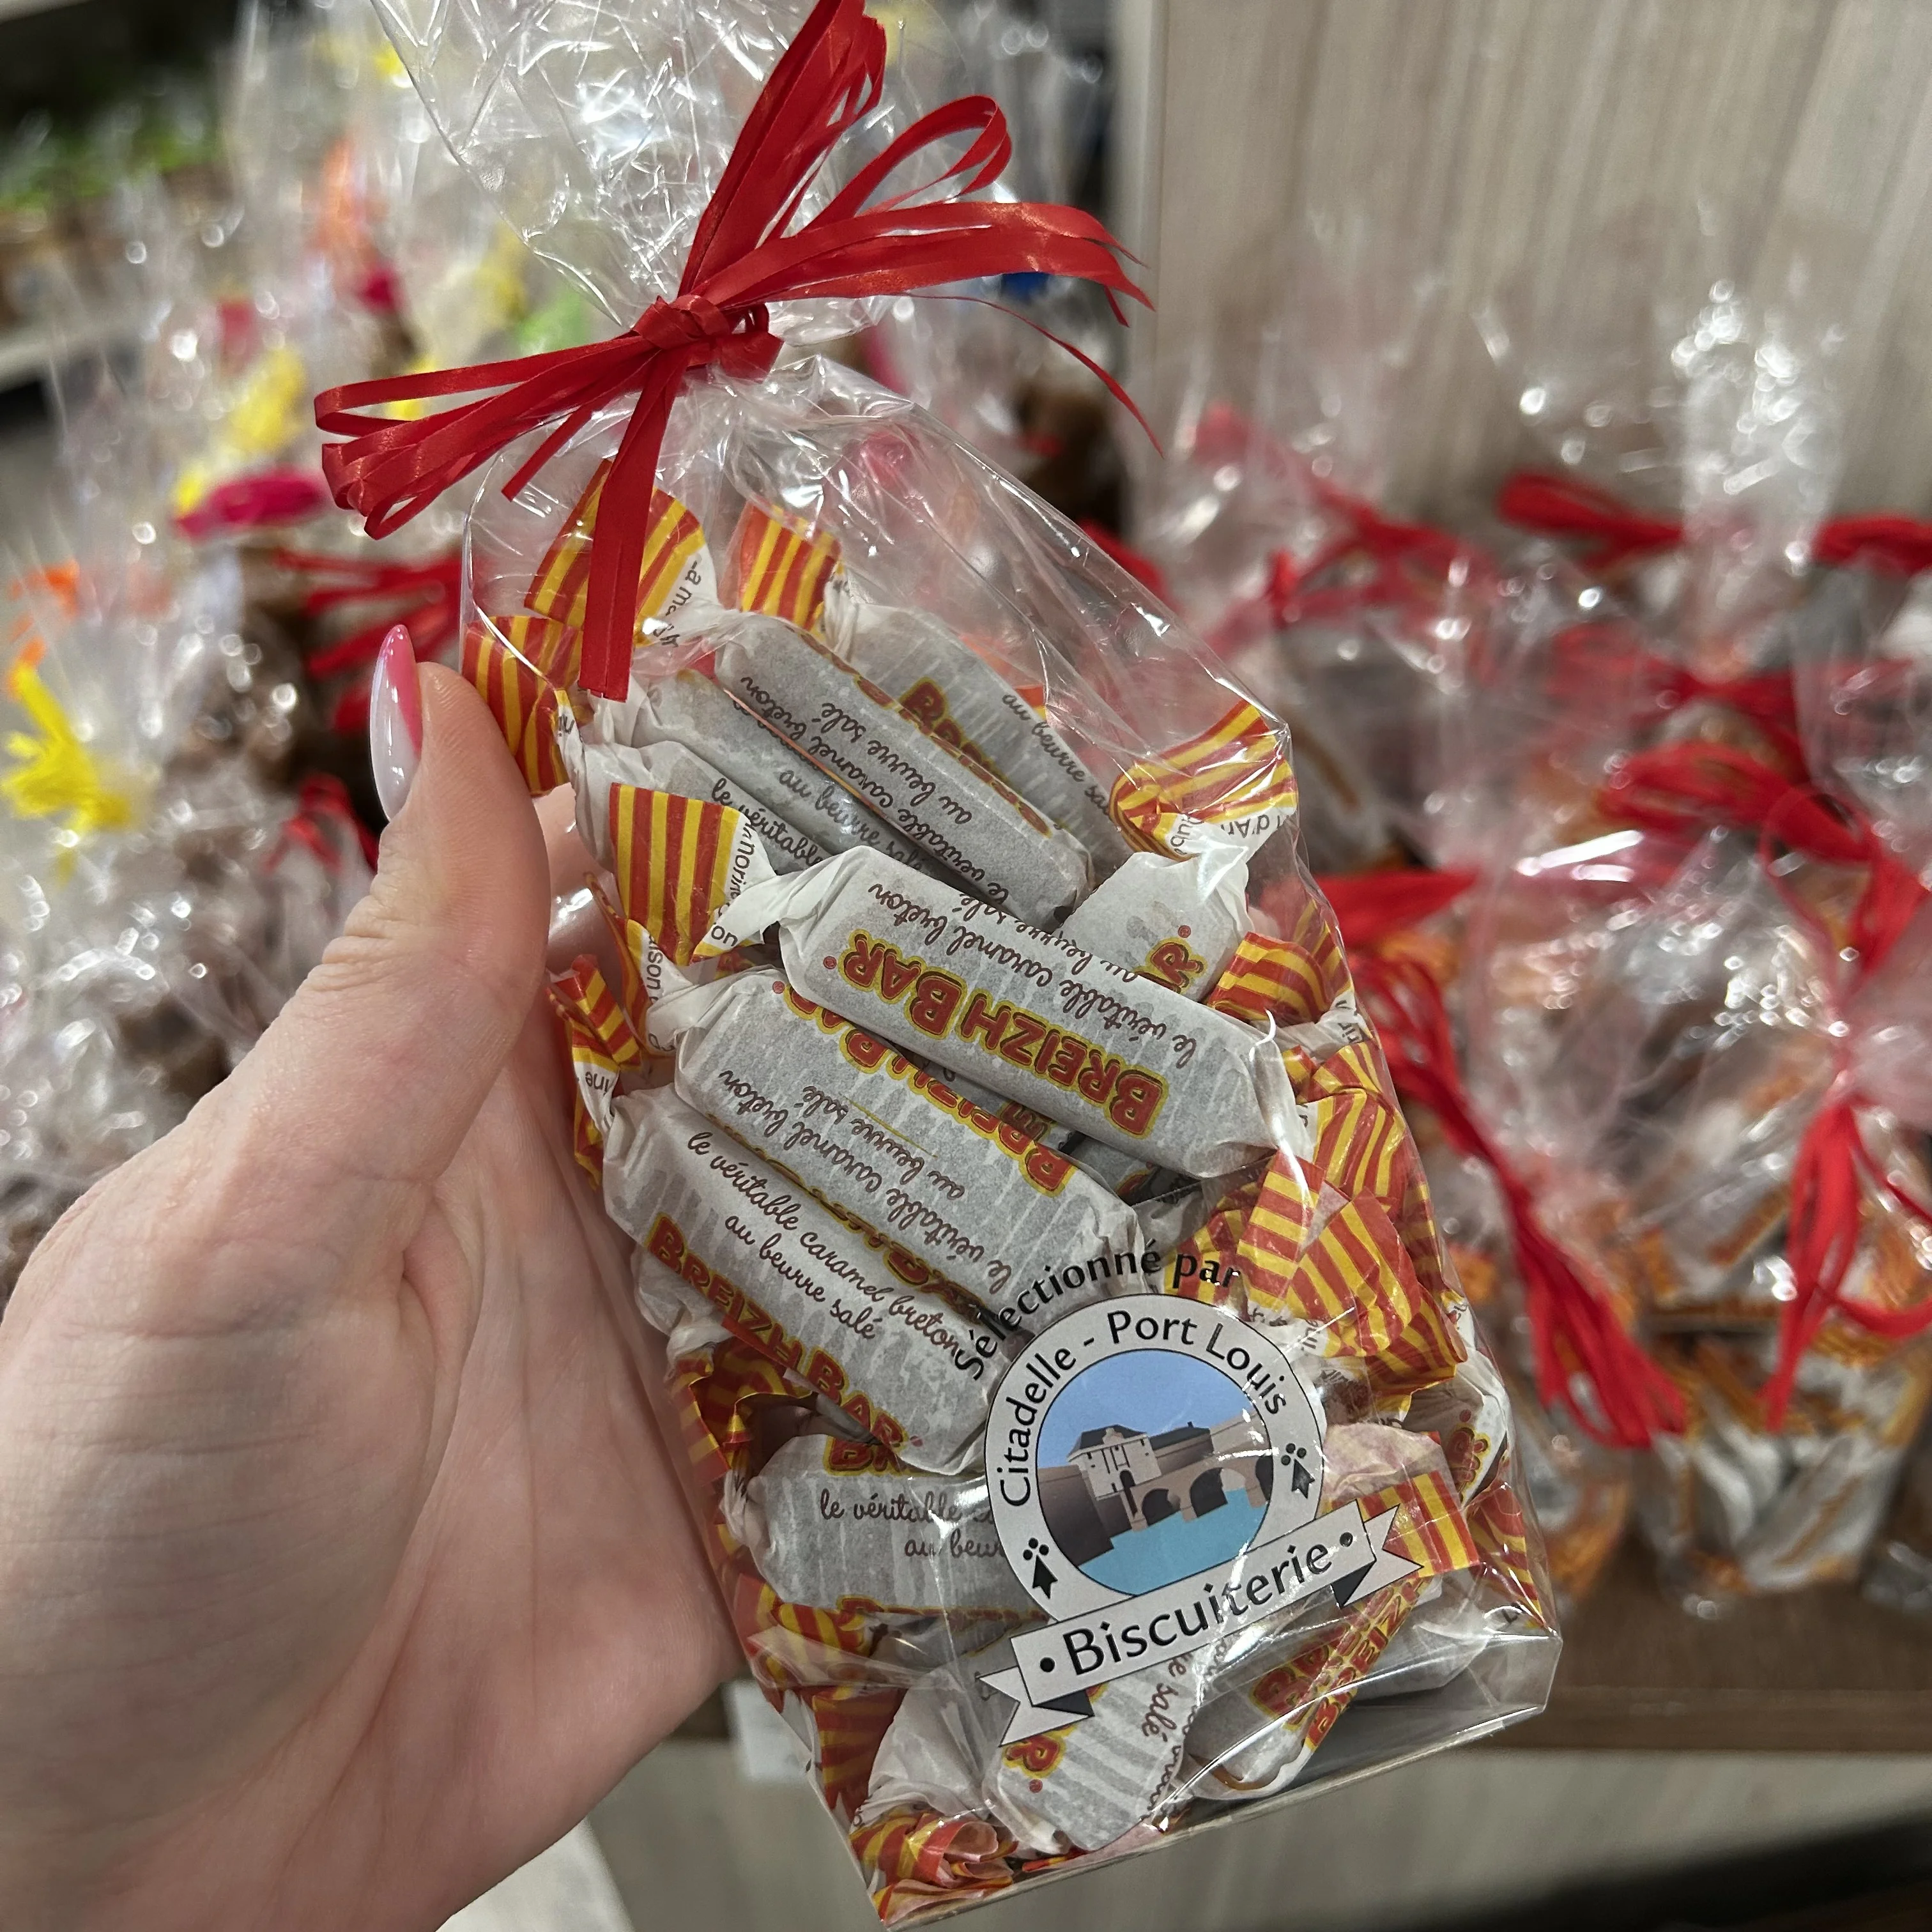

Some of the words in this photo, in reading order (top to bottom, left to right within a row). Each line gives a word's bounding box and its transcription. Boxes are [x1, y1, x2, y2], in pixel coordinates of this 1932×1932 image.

[740, 677, 807, 742] breton
[811, 702, 866, 743] salé
[808, 735, 893, 808] caramel
[867, 740, 937, 807] beurre
[1002, 694, 1031, 721] au
[1032, 720, 1086, 783] beurre
[1084, 785, 1110, 816] sa
[712, 778, 732, 806] le
[779, 770, 811, 798] au
[815, 785, 880, 847] beurre
[939, 795, 972, 824] au
[868, 883, 948, 946] breton
[952, 893, 1007, 924] salé
[987, 882, 1009, 905] le
[841, 931, 965, 1037] BAR
[946, 926, 1053, 987] caramel
[1100, 959, 1139, 983] au
[1059, 979, 1167, 1042] véritable
[958, 991, 1167, 1138] BREIZH
[1172, 1034, 1197, 1069] le
[718, 1070, 789, 1137] breton
[794, 1085, 849, 1124] salé
[784, 1121, 882, 1192] caramel
[850, 1118, 925, 1185] beurre
[927, 1170, 965, 1200] au
[688, 1132, 710, 1155] le
[710, 1162, 801, 1231] véritable
[799, 1230, 894, 1301] caramel
[889, 1295, 962, 1360] breton
[886, 1188, 985, 1262] véritable
[647, 1215, 801, 1371] BREIZH
[725, 1215, 756, 1246] au
[759, 1234, 825, 1303] beurre
[831, 1299, 882, 1340] salé
[956, 1238, 1162, 1379] Sélectionné
[1172, 1252, 1241, 1291] par
[987, 1260, 1012, 1294] le
[1000, 1346, 1077, 1506] Citadelle
[1107, 1310, 1198, 1345] Port
[1206, 1322, 1287, 1415] Louis
[820, 1489, 845, 1519] le
[854, 1491, 962, 1523] véritable
[904, 1538, 942, 1558] au
[950, 1528, 1006, 1558] beu
[1062, 1543, 1332, 1676] Biscuiterie
[1142, 1682, 1179, 1742] salé
